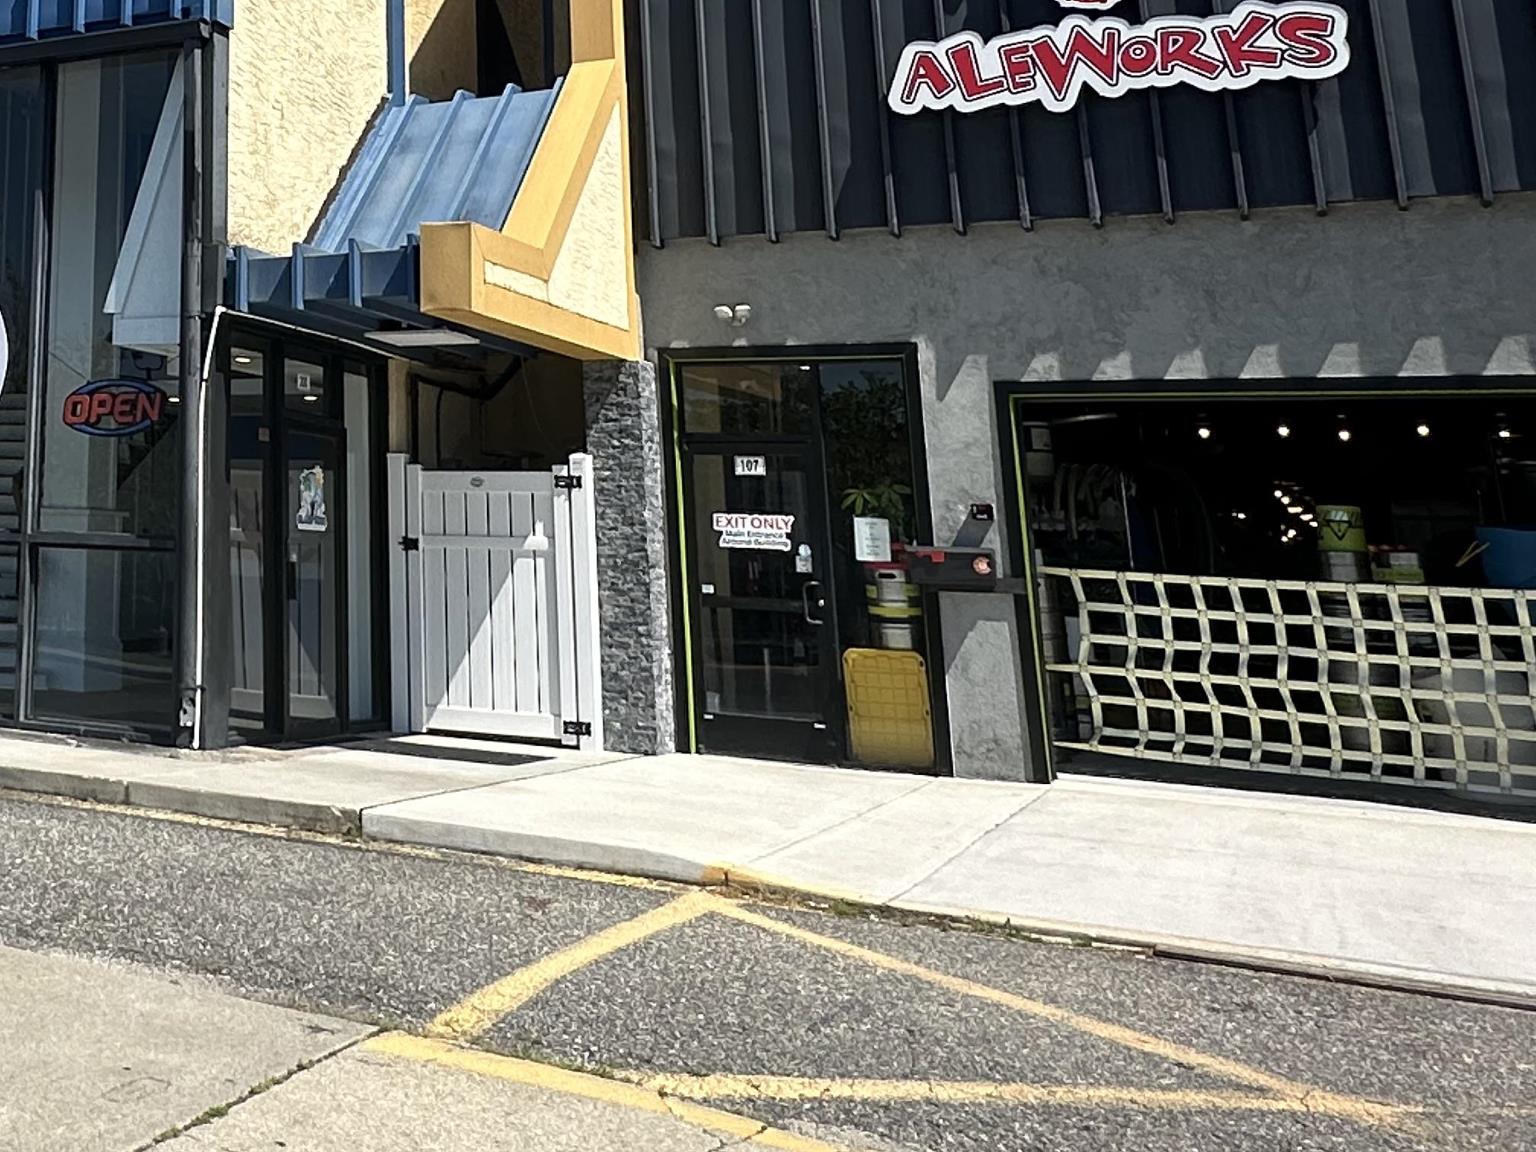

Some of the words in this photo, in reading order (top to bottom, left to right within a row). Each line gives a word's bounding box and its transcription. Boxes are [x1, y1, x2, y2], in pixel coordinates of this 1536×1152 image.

[899, 9, 1337, 104] ALEWORKS
[64, 391, 162, 425] OPEN
[740, 459, 759, 473] 107
[715, 515, 747, 529] EXIT
[750, 517, 791, 530] ONLY
